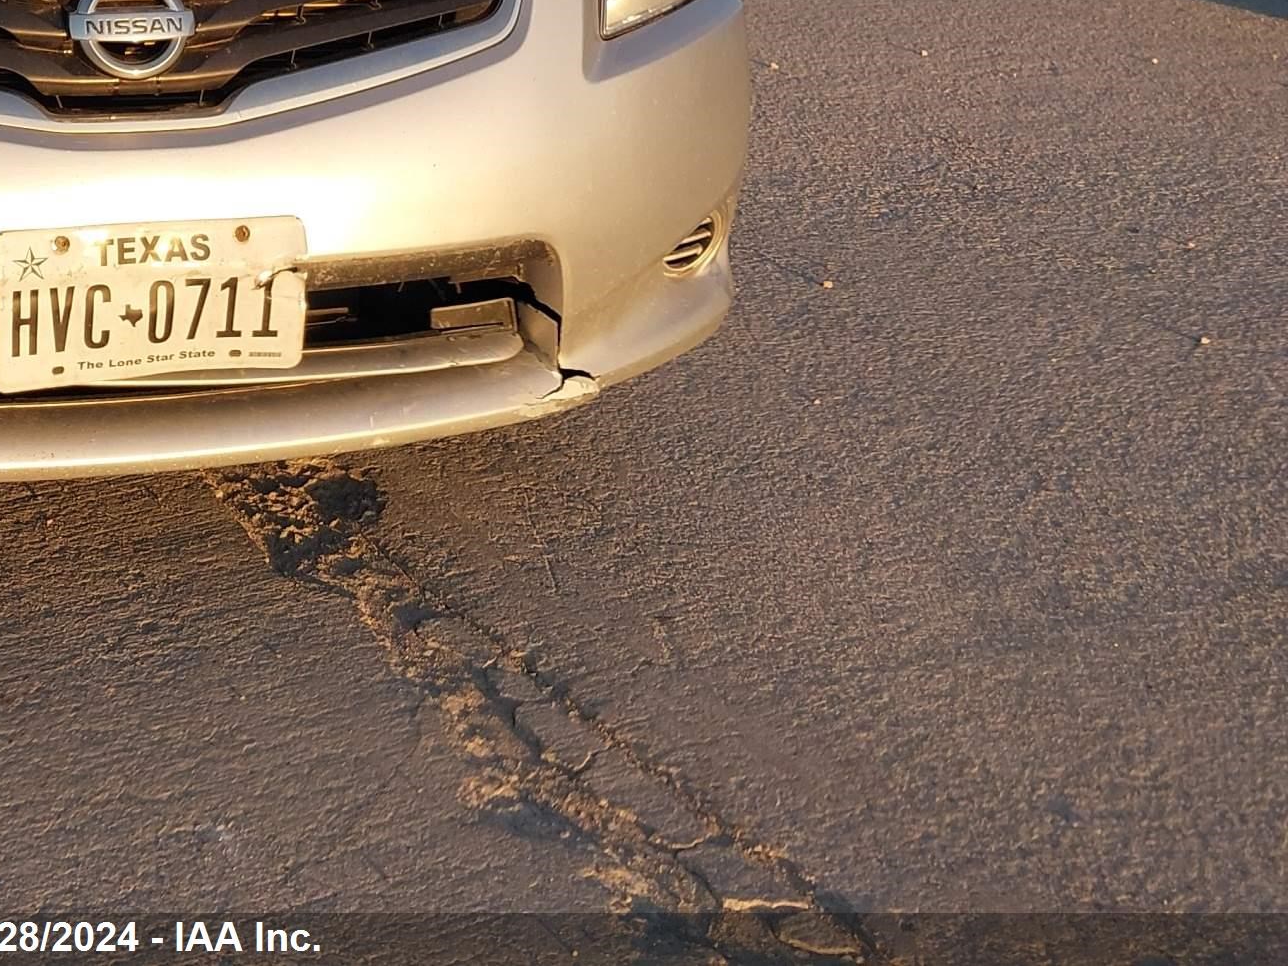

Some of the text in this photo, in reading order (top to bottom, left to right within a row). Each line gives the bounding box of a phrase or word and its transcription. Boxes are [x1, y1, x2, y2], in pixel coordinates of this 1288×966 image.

[85, 17, 183, 35] NISSAN
[94, 233, 211, 267] TEXAS
[11, 277, 279, 358] HVC 0711
[77, 350, 216, 370] The Lone Star State
